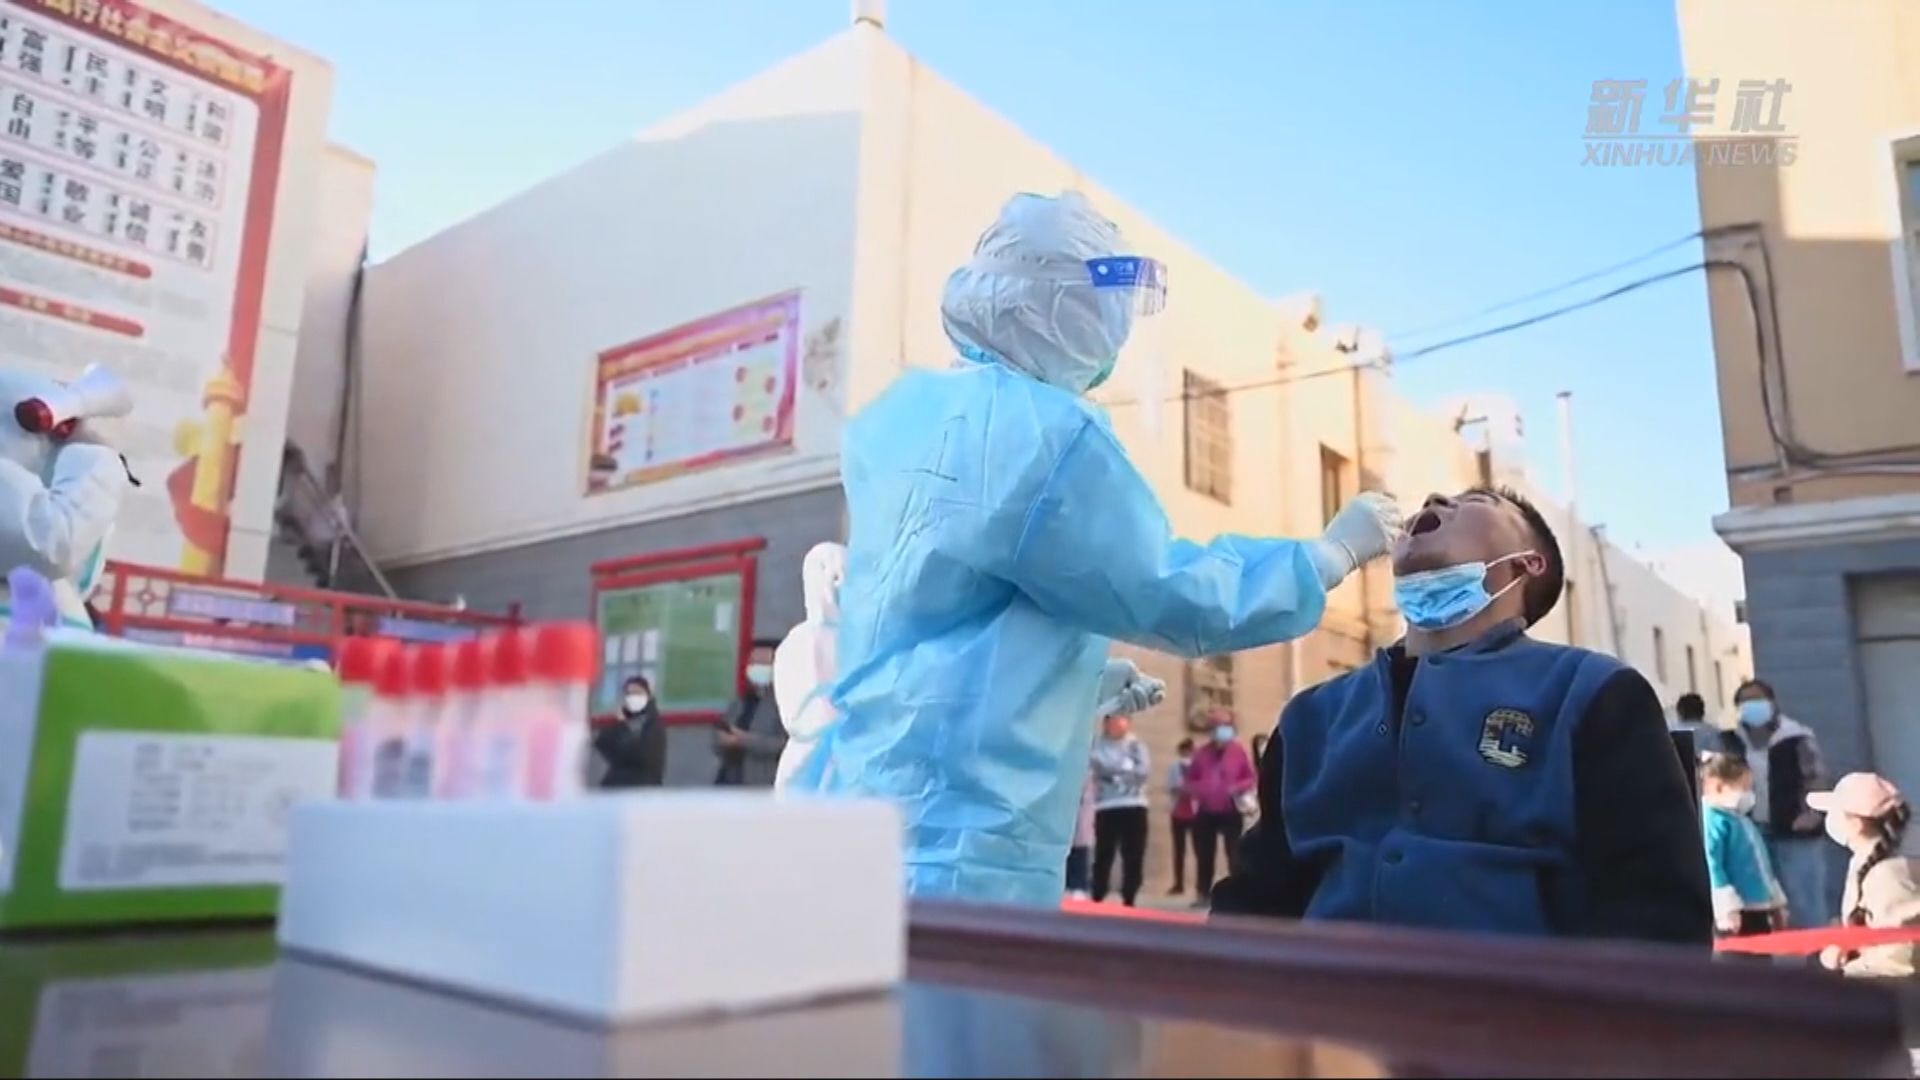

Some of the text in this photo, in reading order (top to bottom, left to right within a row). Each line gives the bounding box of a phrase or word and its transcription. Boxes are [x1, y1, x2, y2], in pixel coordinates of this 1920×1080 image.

[19, 27, 47, 73] 富强
[8, 93, 34, 140] 自由
[144, 79, 168, 122] 文明
[73, 117, 98, 159] 平等
